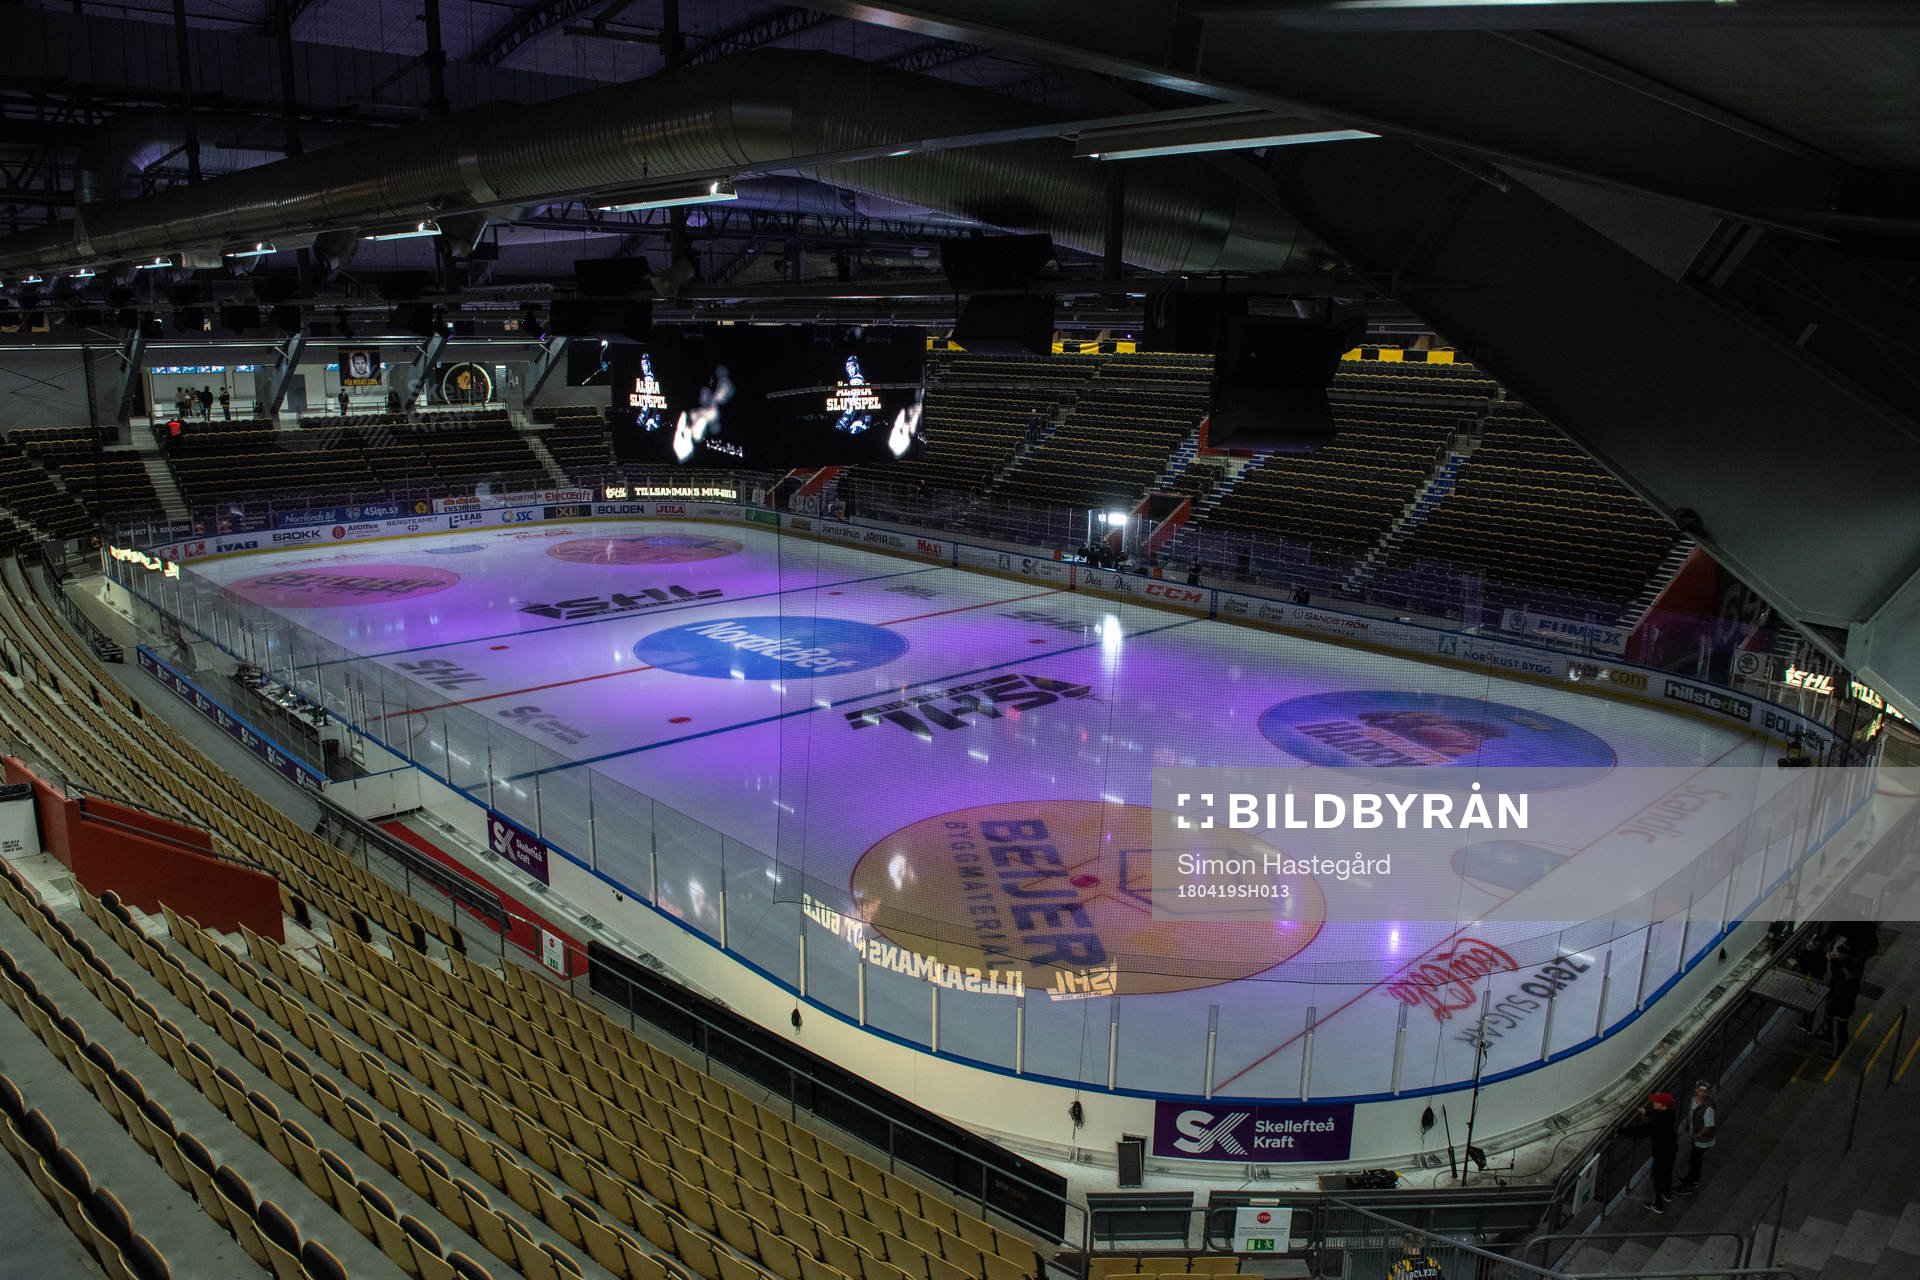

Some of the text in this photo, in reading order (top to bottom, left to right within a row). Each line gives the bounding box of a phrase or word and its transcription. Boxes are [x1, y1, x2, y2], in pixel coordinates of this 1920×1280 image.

[826, 396, 882, 412] SLUTSPEL
[545, 489, 593, 502] Elecosoft
[515, 510, 533, 522] SSC
[598, 505, 645, 514] BOLIDEN
[657, 504, 685, 514] JULA
[386, 516, 438, 526] BERGTEAMET
[459, 512, 482, 521] LEAB
[347, 523, 379, 532] AllOffice
[272, 528, 321, 542] BROKK
[216, 540, 258, 553] IVAB
[917, 539, 942, 555] MAXI
[1145, 583, 1203, 603] CCM
[1304, 611, 1369, 630] SANDSTRÖM
[685, 619, 855, 674] NordicBet
[1522, 662, 1552, 674] BYGG
[1785, 664, 1835, 695] SHL
[1666, 682, 1750, 718] hillstedts
[980, 819, 1106, 967] BEIJER
[1173, 1109, 1250, 1155] SK
[1255, 1117, 1335, 1134] Skellefteå
[1254, 1135, 1295, 1148] Kraft
